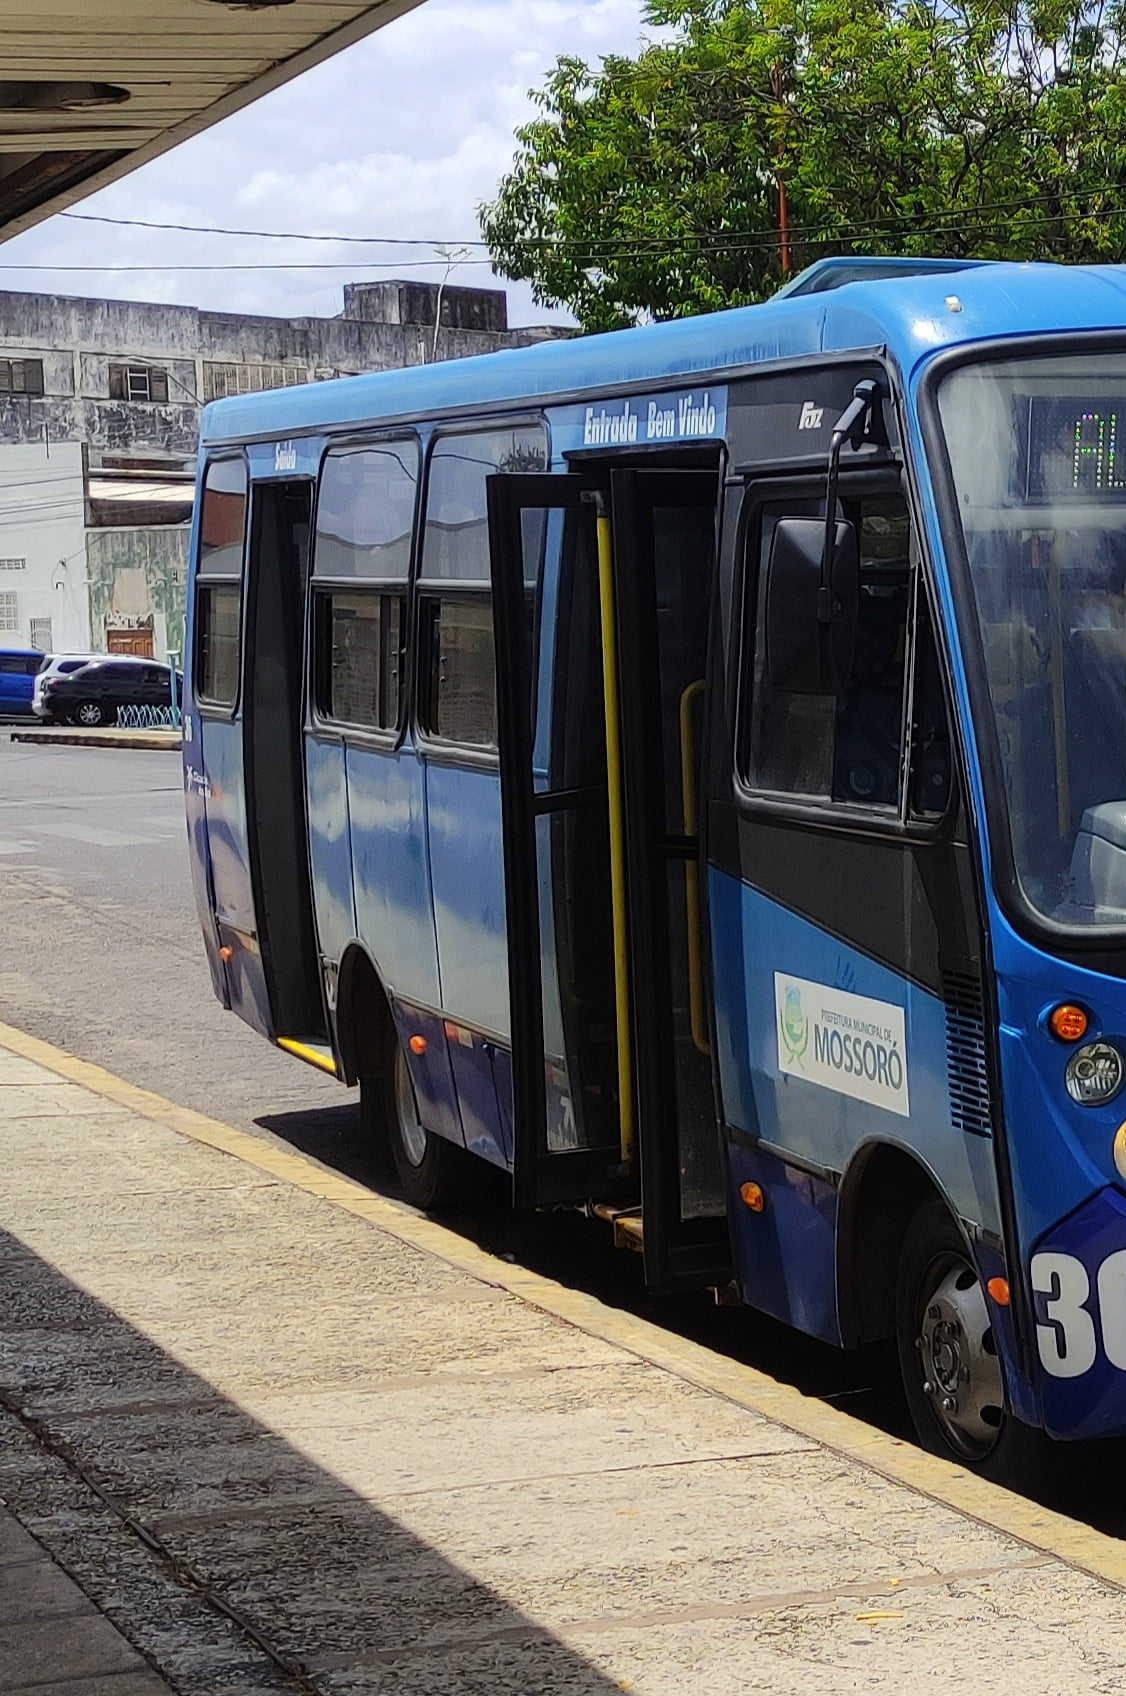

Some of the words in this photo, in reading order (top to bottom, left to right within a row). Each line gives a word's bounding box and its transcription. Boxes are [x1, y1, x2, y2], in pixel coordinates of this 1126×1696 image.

[584, 401, 638, 445] Entrada
[646, 401, 675, 439] Bem
[678, 392, 716, 436] Vindo
[820, 1008, 853, 1031] PREFEITURA
[853, 1019, 883, 1040] MUNICIPAL
[883, 1026, 892, 1042] DE
[814, 1023, 903, 1090] MOSSORÓ
